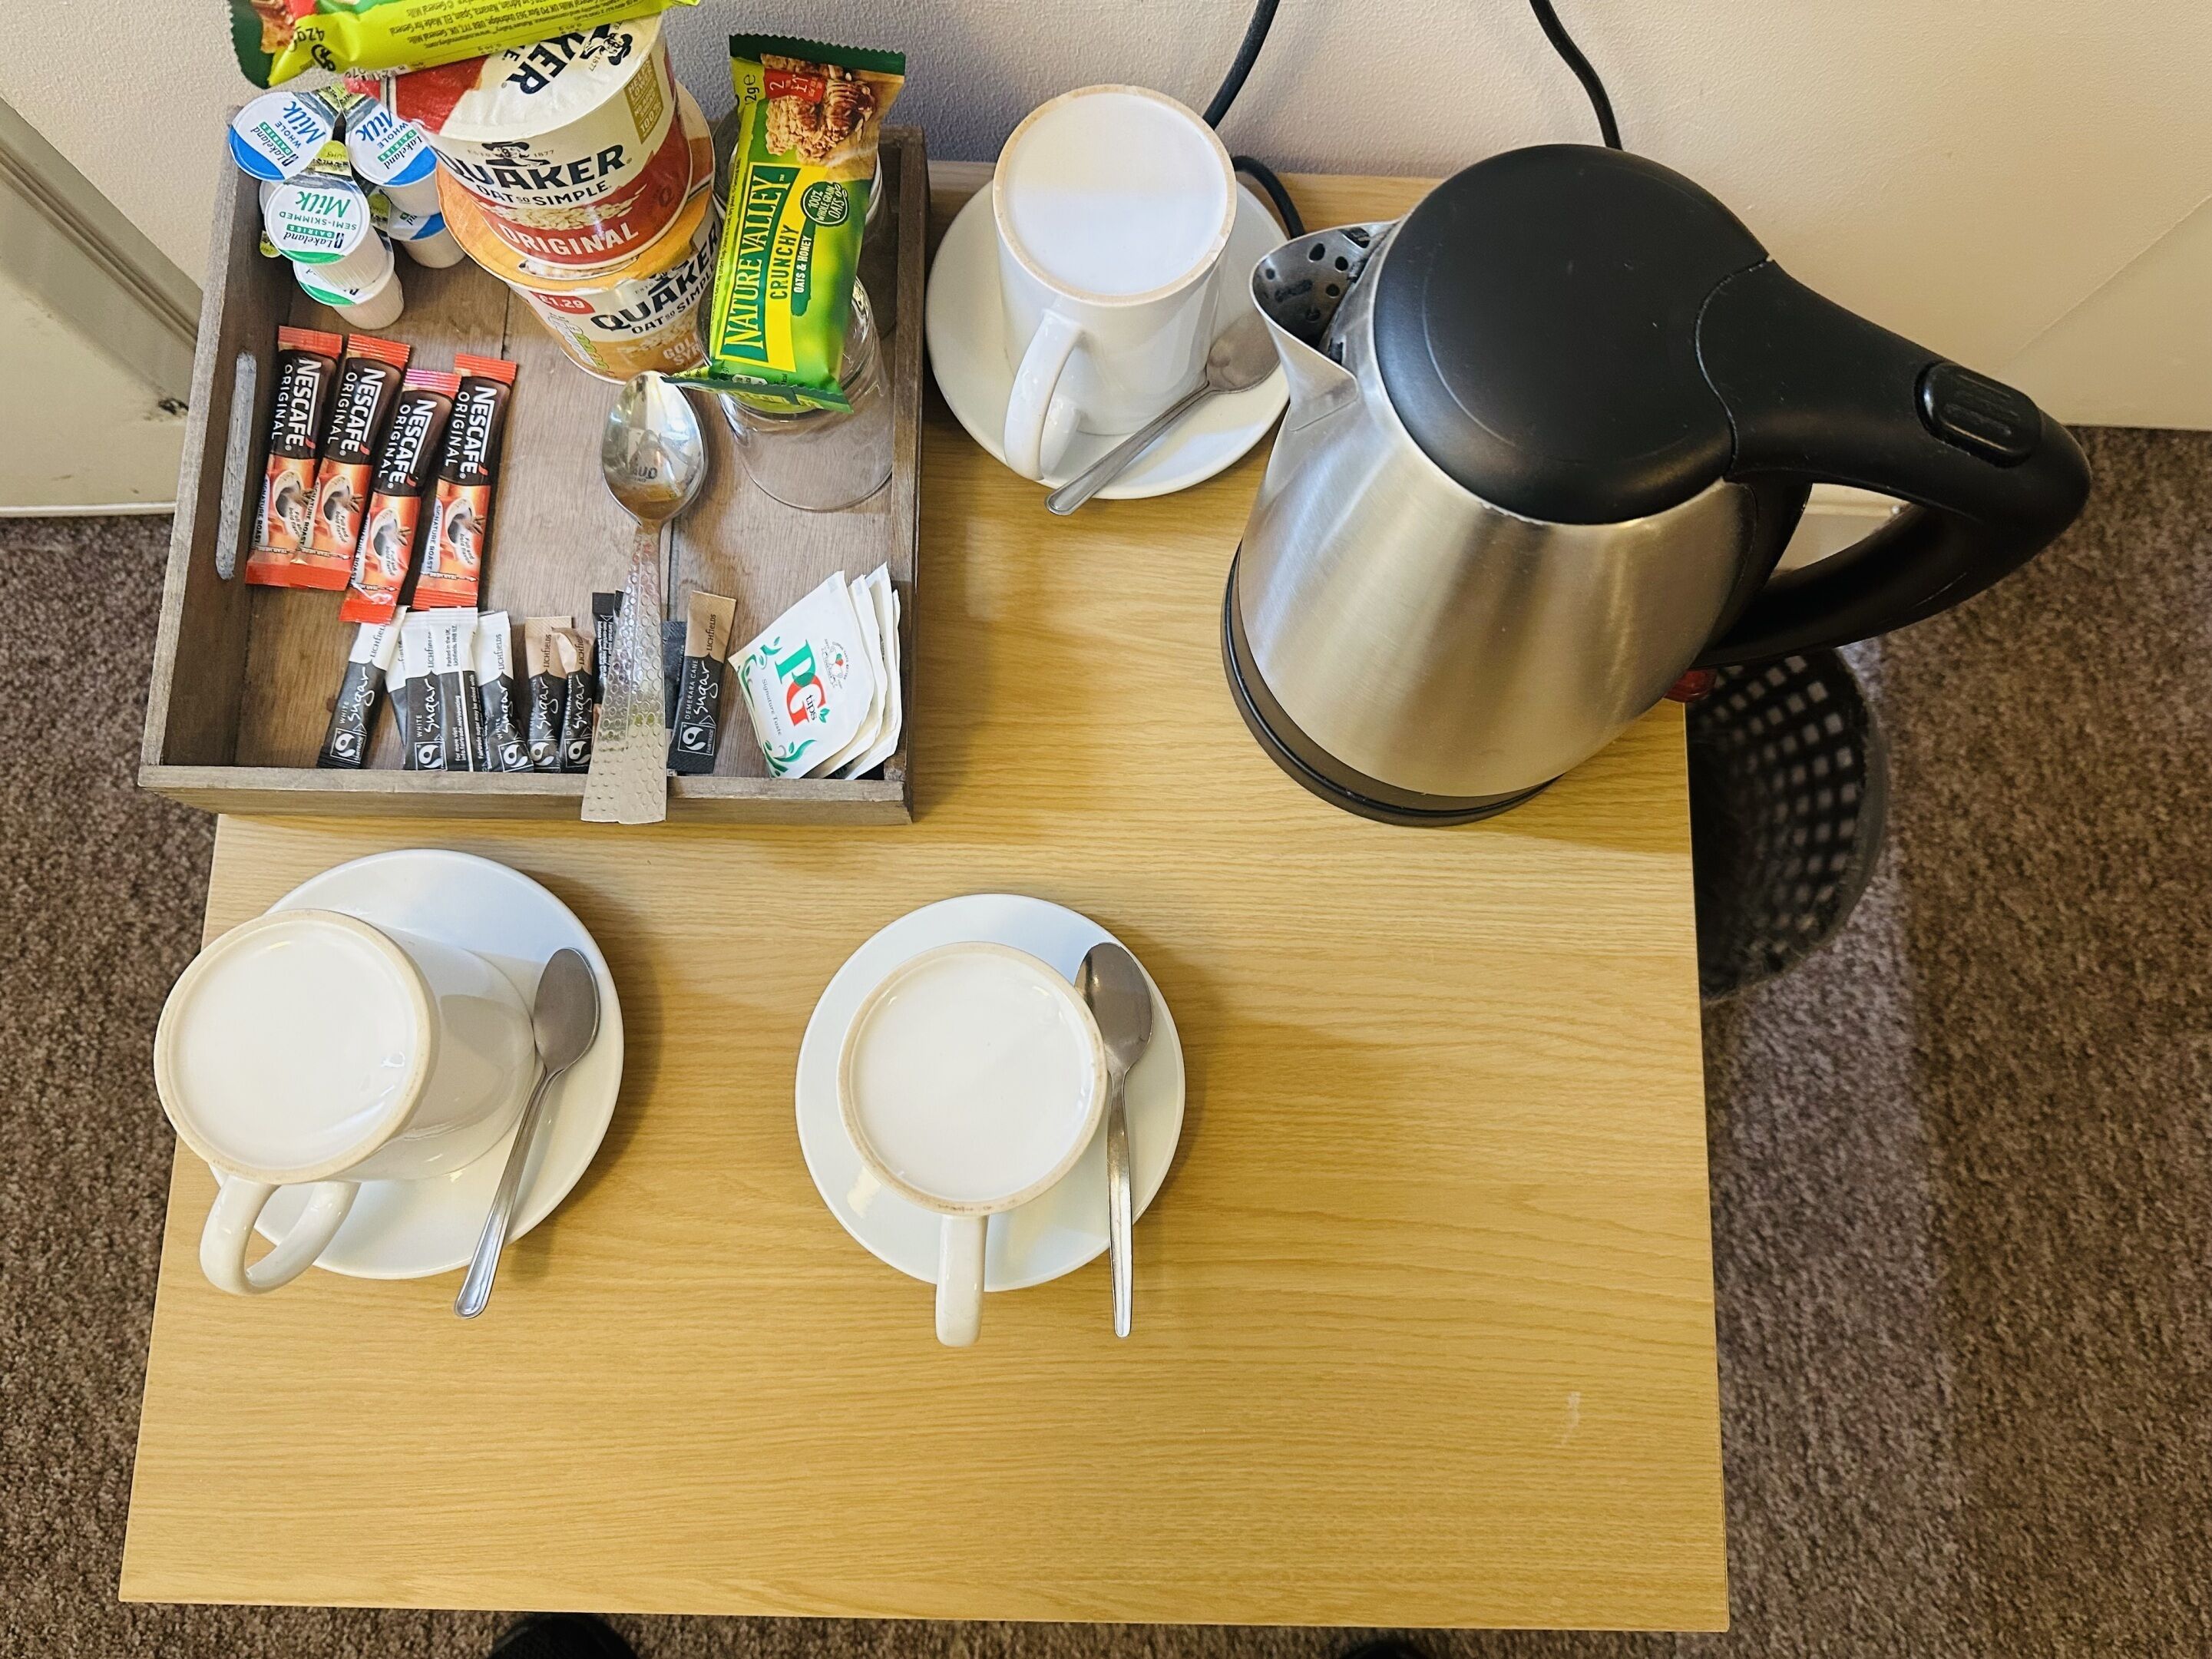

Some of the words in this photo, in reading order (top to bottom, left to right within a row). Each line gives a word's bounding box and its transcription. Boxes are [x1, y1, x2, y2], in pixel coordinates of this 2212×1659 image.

[507, 32, 586, 98] KER
[274, 120, 301, 149] WHOLE
[280, 101, 326, 144] Milk
[376, 122, 408, 149] WHOLE
[250, 126, 286, 162] Lakeland
[383, 135, 422, 169] Lakeland
[431, 144, 626, 190] QUAKER
[294, 190, 351, 217] Milk
[476, 185, 513, 203] OAT
[806, 188, 824, 210] 100%
[815, 200, 830, 221] WHOLE
[822, 184, 836, 203] GRAIN
[827, 197, 845, 219] OATS
[279, 210, 357, 231] SEMI-SKIMMED
[287, 225, 332, 237] DAIRIES
[283, 231, 332, 248] Lakeland
[498, 222, 639, 256] ORIGINAL
[590, 221, 718, 332] QUAKER
[770, 224, 799, 300] CRUNCHY
[794, 277, 807, 293] OATS
[801, 236, 812, 262] HONEY
[724, 259, 764, 349] NATURE
[631, 316, 664, 335] OAT
[271, 364, 293, 440] ORIGINAL
[327, 372, 357, 444] ORIGINAL
[378, 405, 411, 478] ORIGINAL
[445, 392, 470, 467] ORIGINAL
[255, 520, 263, 543] ROAST
[300, 522, 309, 545] ROAST
[430, 505, 441, 544] SIGNATURE
[426, 545, 435, 570] ROAST
[348, 666, 375, 722] sugar
[685, 680, 696, 719] DEMERARA
[693, 660, 718, 715] sugar
[762, 678, 775, 715] Signature
[775, 639, 827, 727] PG
[339, 702, 349, 723] WHITE
[424, 679, 440, 733] sugar
[497, 681, 514, 733] sugar
[537, 676, 559, 729] sugar
[573, 675, 592, 729] sugar
[805, 694, 817, 721] tips
[706, 728, 714, 753] FAIRTRADE
